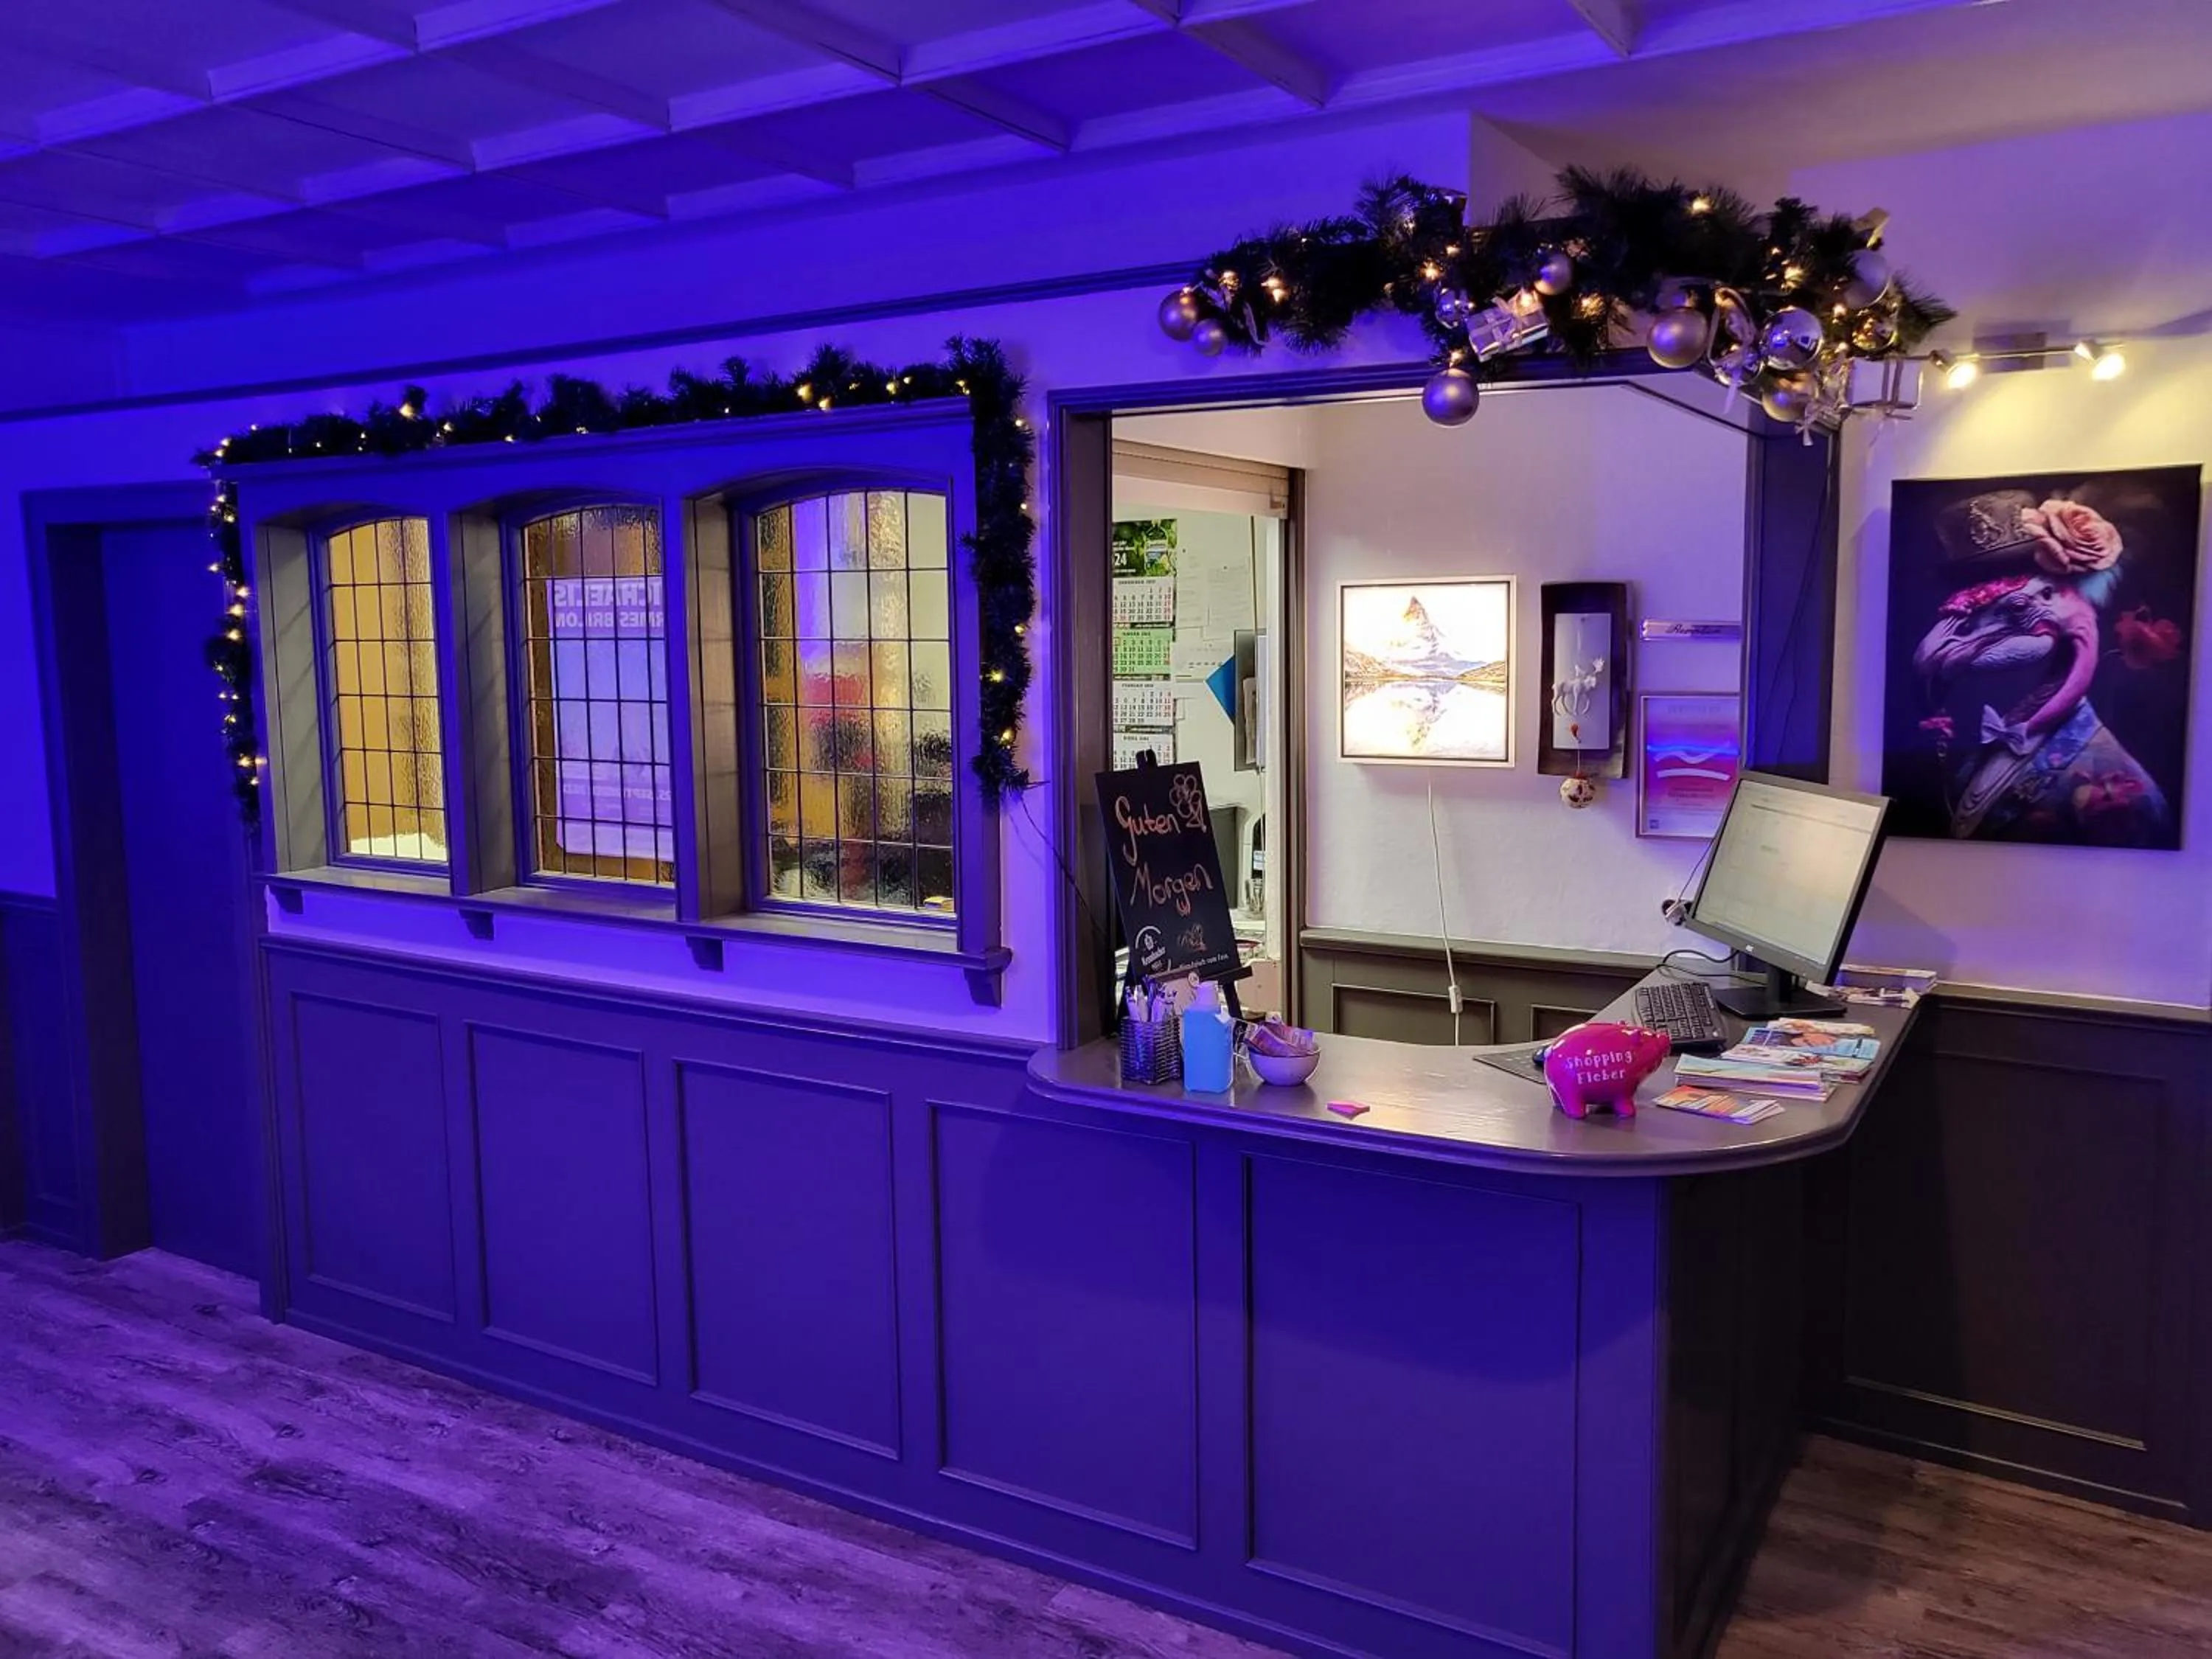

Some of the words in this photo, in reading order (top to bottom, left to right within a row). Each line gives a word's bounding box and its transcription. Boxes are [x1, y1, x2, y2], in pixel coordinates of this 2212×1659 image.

[1113, 552, 1127, 566] 24
[1114, 796, 1181, 866] Guten
[1130, 863, 1214, 917] Morgen
[1565, 1051, 1633, 1068] Shopping
[1576, 1069, 1627, 1085] Fieber
